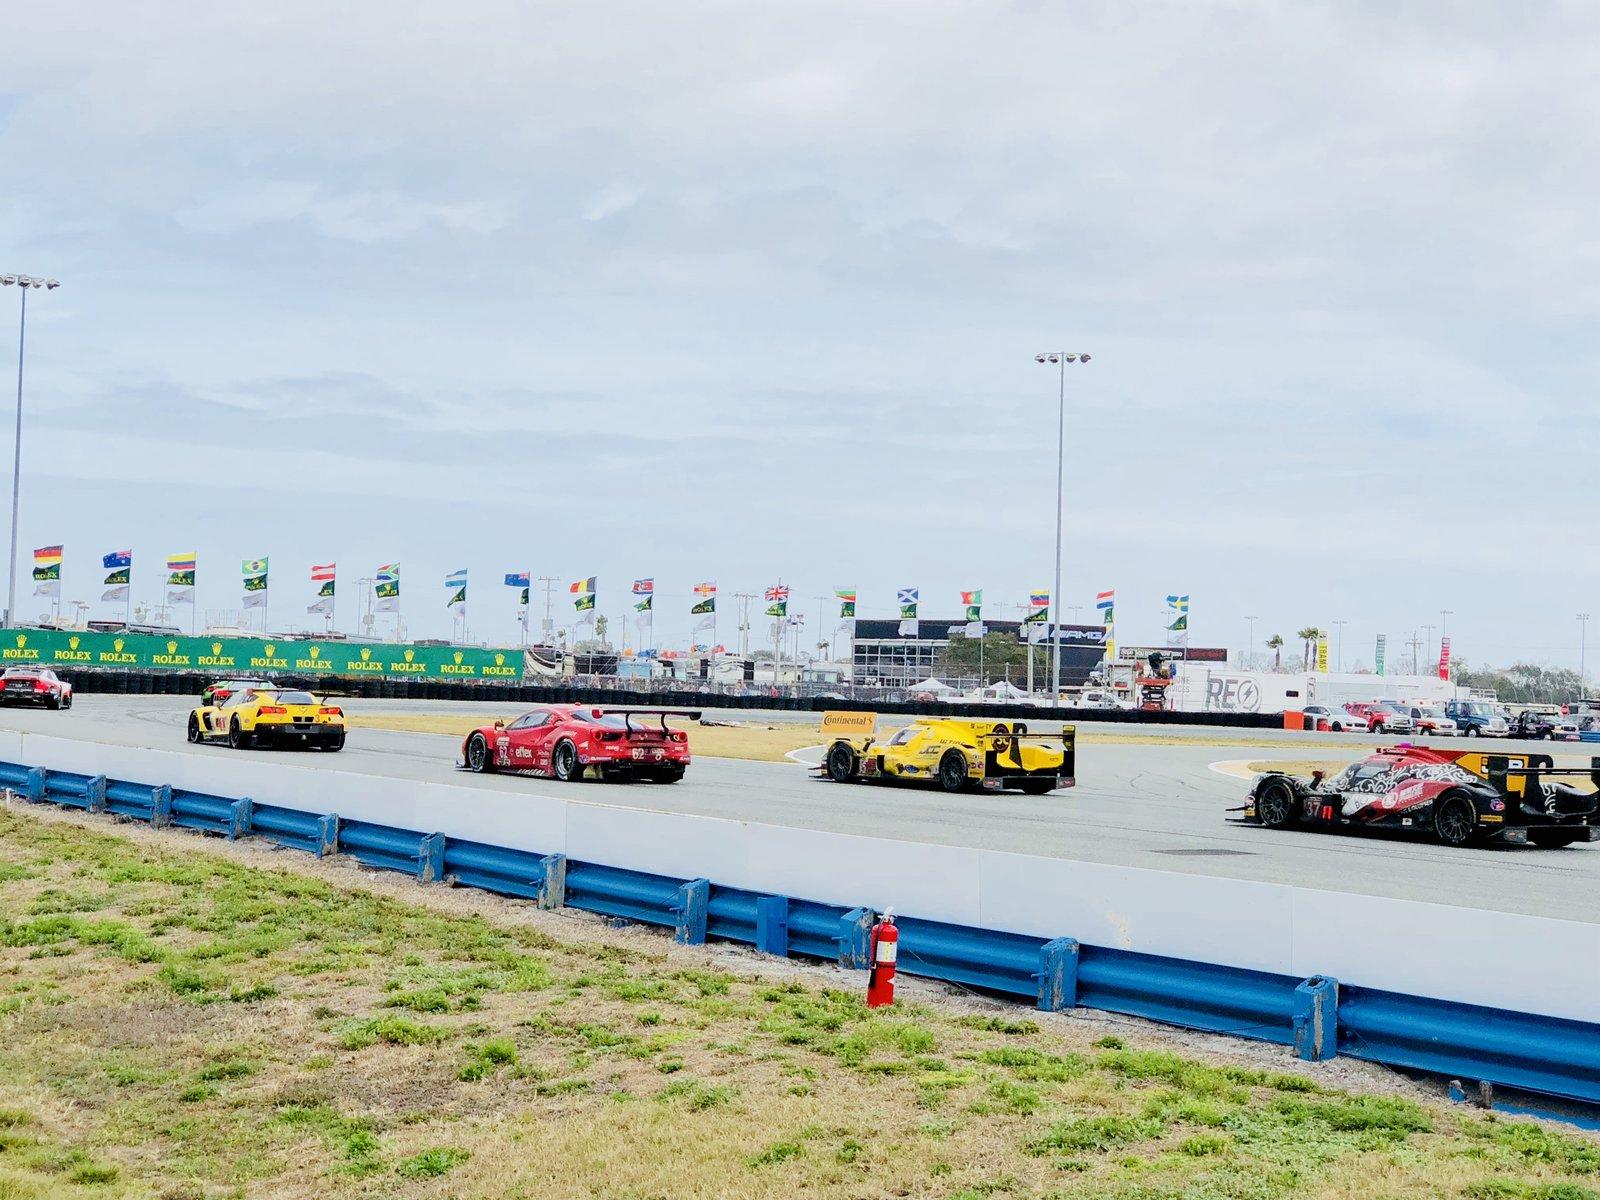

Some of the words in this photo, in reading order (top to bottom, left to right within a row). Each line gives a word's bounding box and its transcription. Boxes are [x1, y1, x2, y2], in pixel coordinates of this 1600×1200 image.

[3, 650, 39, 659] ROLEX
[54, 651, 91, 660] ROLEX
[100, 653, 137, 663] ROLEX
[1319, 645, 1328, 671] TRAMS
[152, 655, 190, 664] ROLEX
[198, 657, 235, 666] ROLEX
[251, 658, 287, 667] ROLEX
[296, 660, 332, 669] ROLEX
[347, 662, 383, 671] ROLEX
[390, 663, 426, 672] ROLEX
[440, 665, 475, 674] ROLEX
[482, 667, 516, 675] ROLEX
[824, 715, 867, 726] Continental
[515, 746, 532, 758] effex
[632, 747, 645, 760] 62
[1307, 801, 1321, 817] 37
